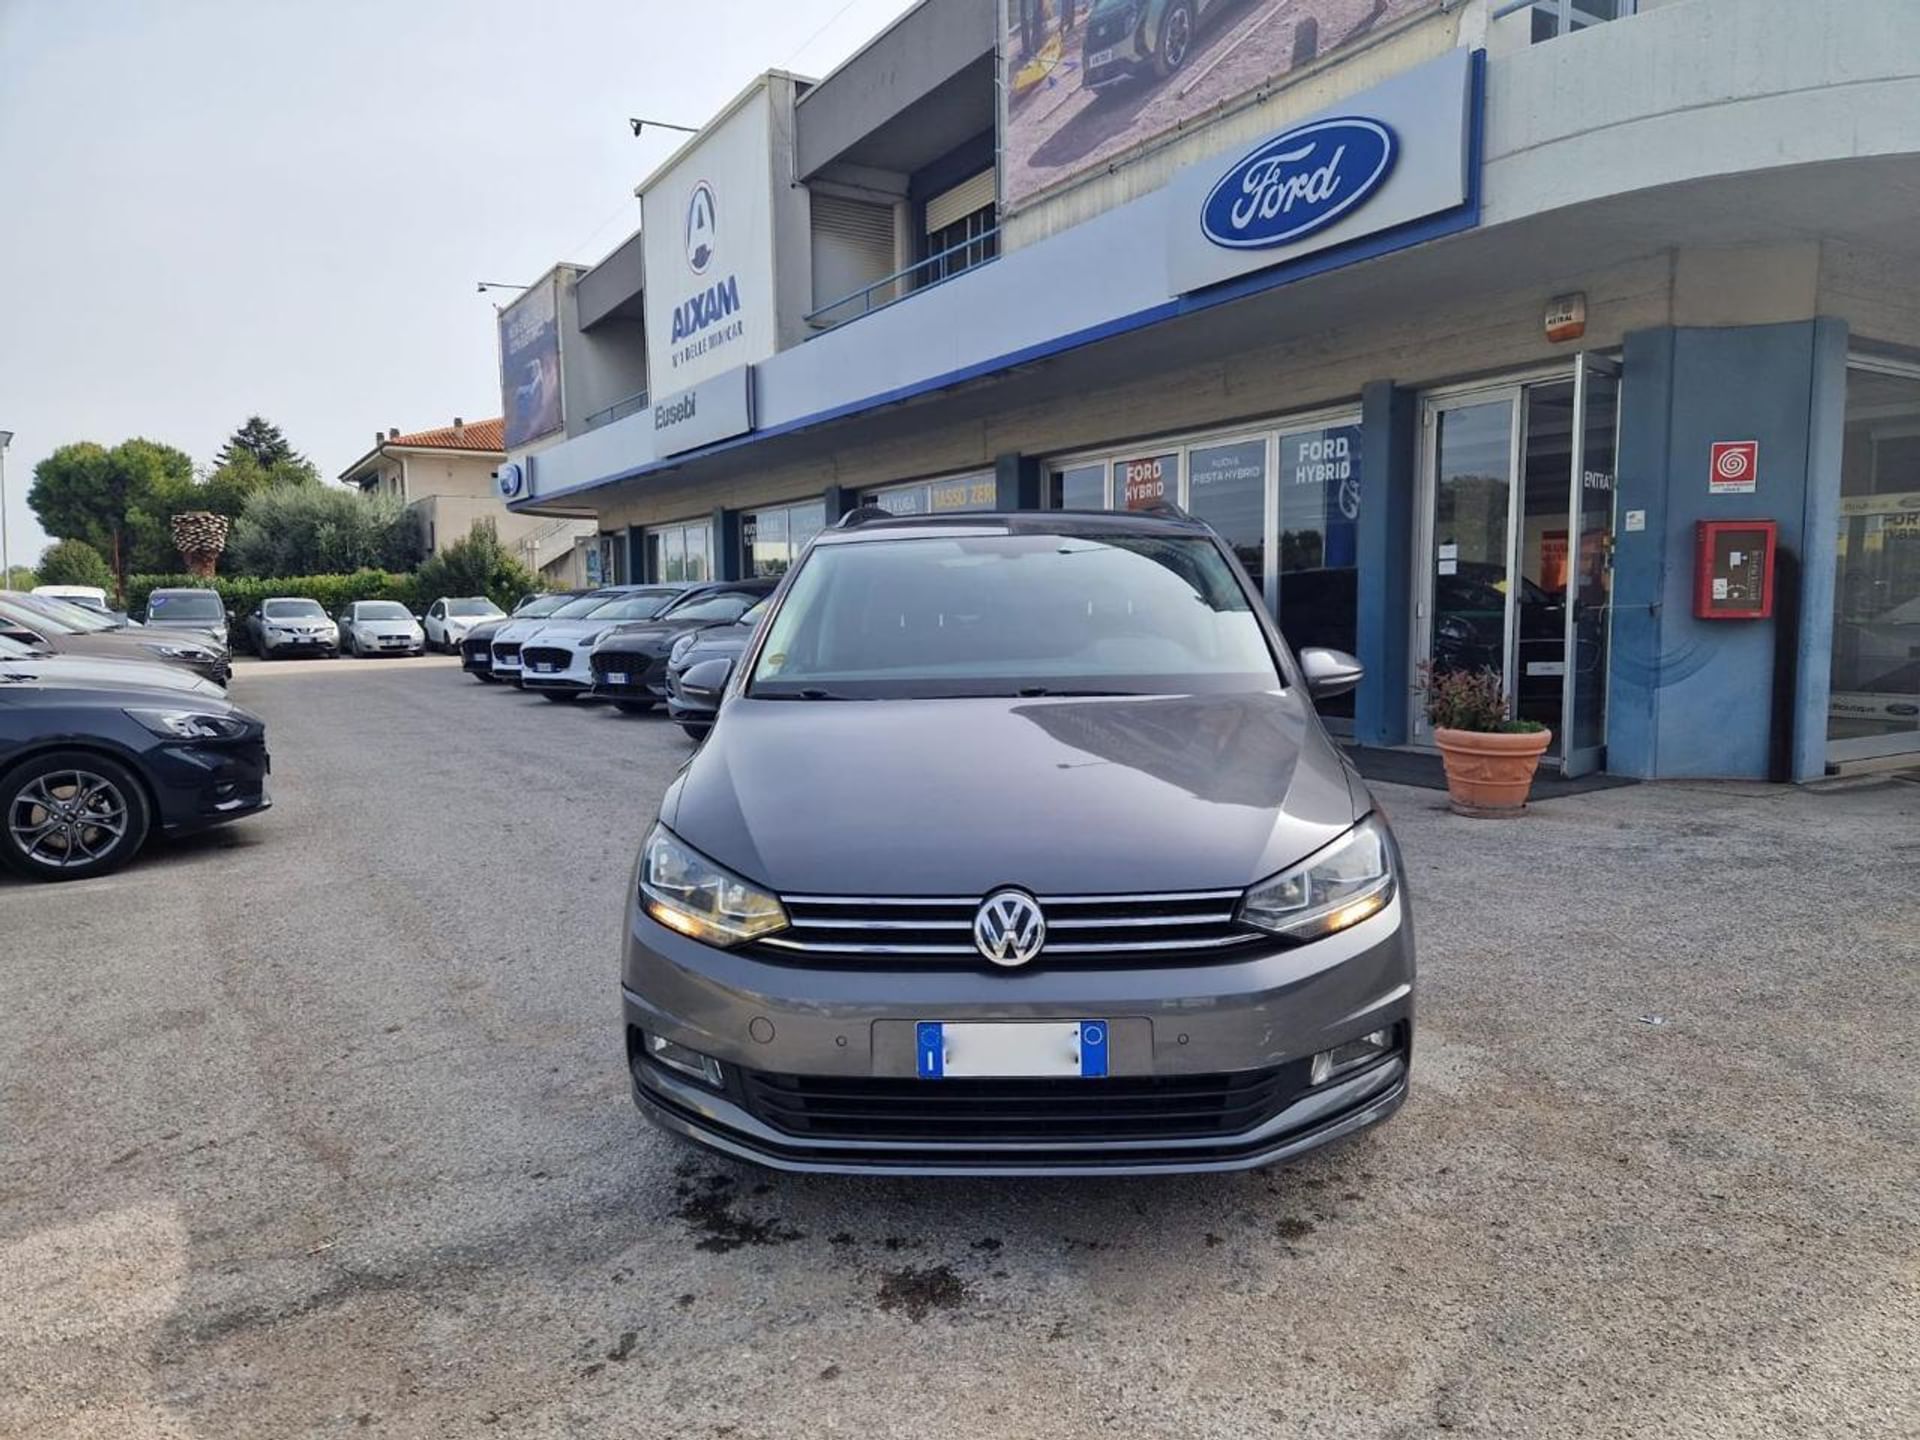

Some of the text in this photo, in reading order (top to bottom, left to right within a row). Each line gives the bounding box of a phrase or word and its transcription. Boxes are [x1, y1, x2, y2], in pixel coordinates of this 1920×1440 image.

[1231, 142, 1346, 229] Ford
[671, 275, 741, 345] AIXAM
[685, 340, 707, 362] DELLE
[708, 320, 744, 350] MINICAR
[654, 391, 696, 430] Eusebi
[1299, 437, 1349, 463] FORD
[1126, 460, 1162, 483] FORD
[1296, 461, 1351, 485] HYBRID
[1124, 481, 1164, 501] HYBRID
